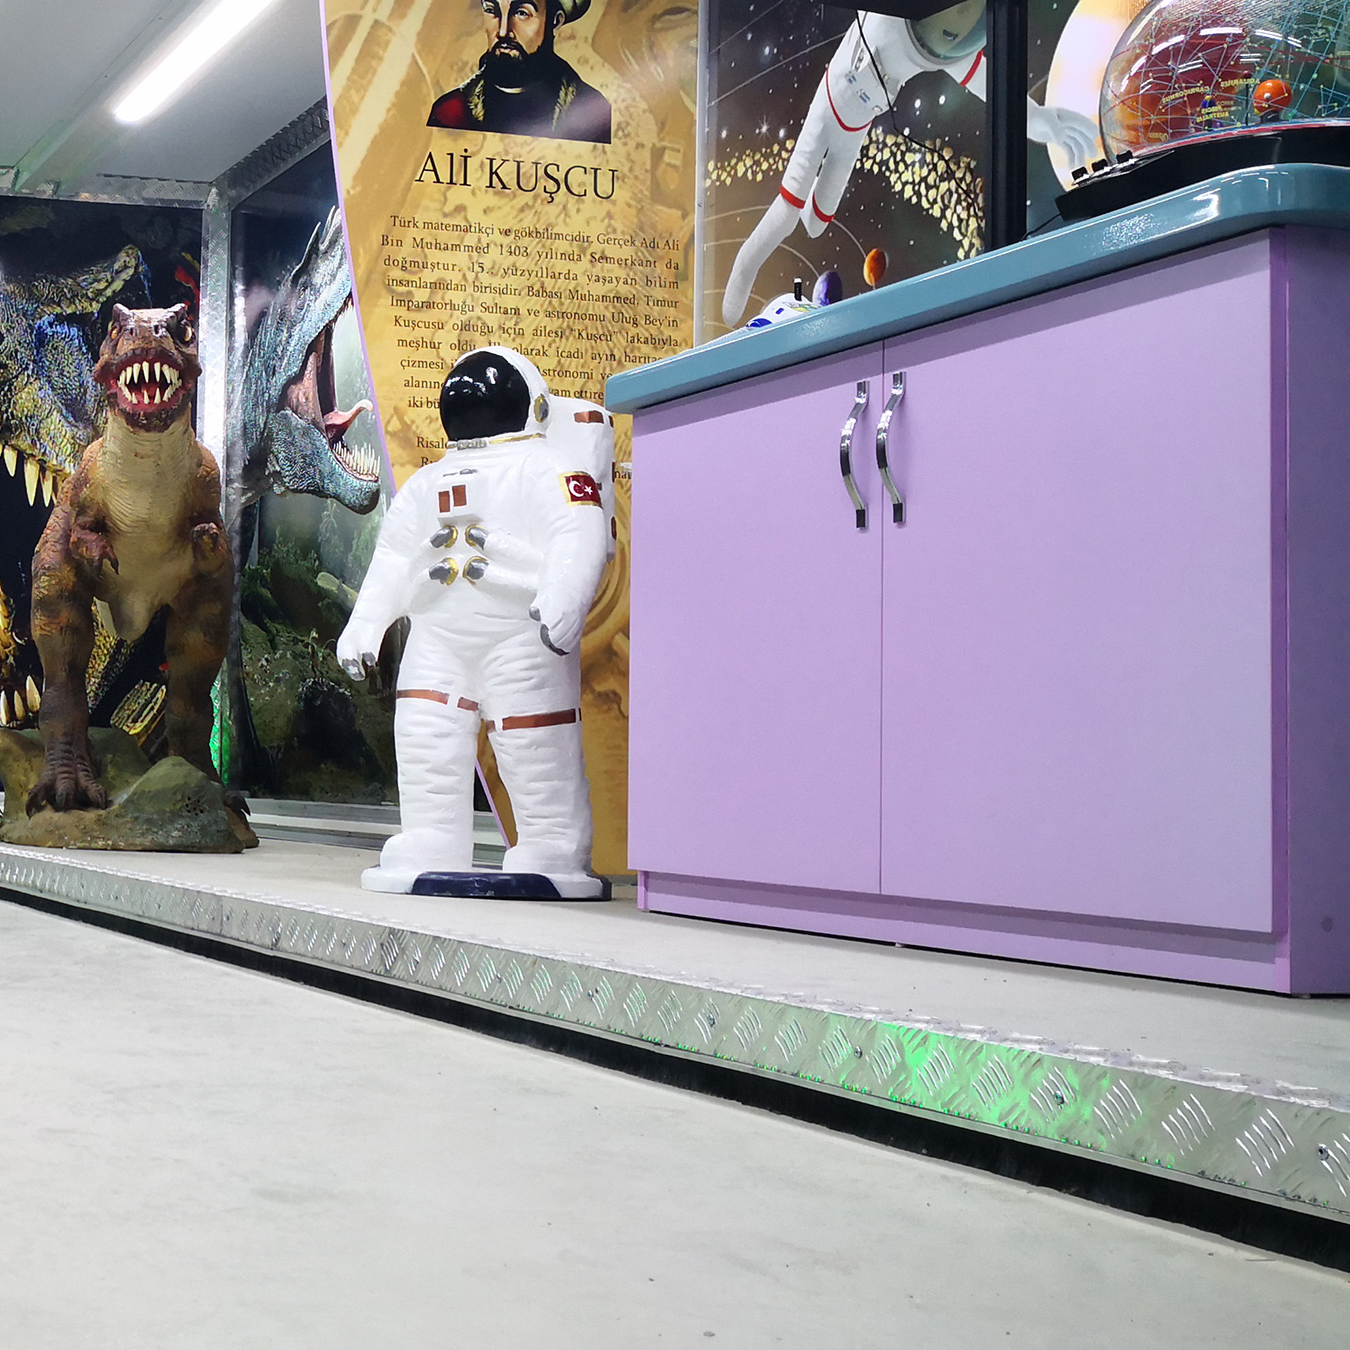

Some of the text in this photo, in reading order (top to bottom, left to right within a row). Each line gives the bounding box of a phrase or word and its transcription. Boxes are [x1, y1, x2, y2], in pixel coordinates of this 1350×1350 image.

[485, 157, 619, 204] KUŞCU
[390, 214, 680, 251] Türk matematikçi ve gökbilimcidir. Gerçek Adı Ali
[381, 234, 680, 271] Bin Muhammed 1403 yılında Semerkant da
[383, 254, 461, 273] doğmuştur.
[502, 265, 578, 282] yüzyıllarda
[586, 273, 637, 288] yaşayan
[645, 275, 680, 290] bilim
[386, 275, 467, 293] insanlarından
[472, 280, 522, 297] birisidir.
[527, 286, 563, 300] Babası
[643, 294, 680, 309] Timur
[394, 314, 444, 331] Kuşcusu
[451, 319, 494, 336] olduğu
[501, 323, 525, 338] için
[625, 331, 679, 349] lakabıyla
[479, 301, 521, 316] Sultanı
[526, 308, 540, 318] ve
[545, 309, 606, 323] astronomu
[611, 311, 639, 328] Uluğ
[397, 337, 443, 352] meşhur
[512, 343, 549, 358] olarak
[556, 346, 584, 360] icadı
[591, 351, 617, 364] ayın
[400, 355, 444, 371] çizmesi
[408, 398, 423, 409] iki
[574, 389, 604, 400] ettire
